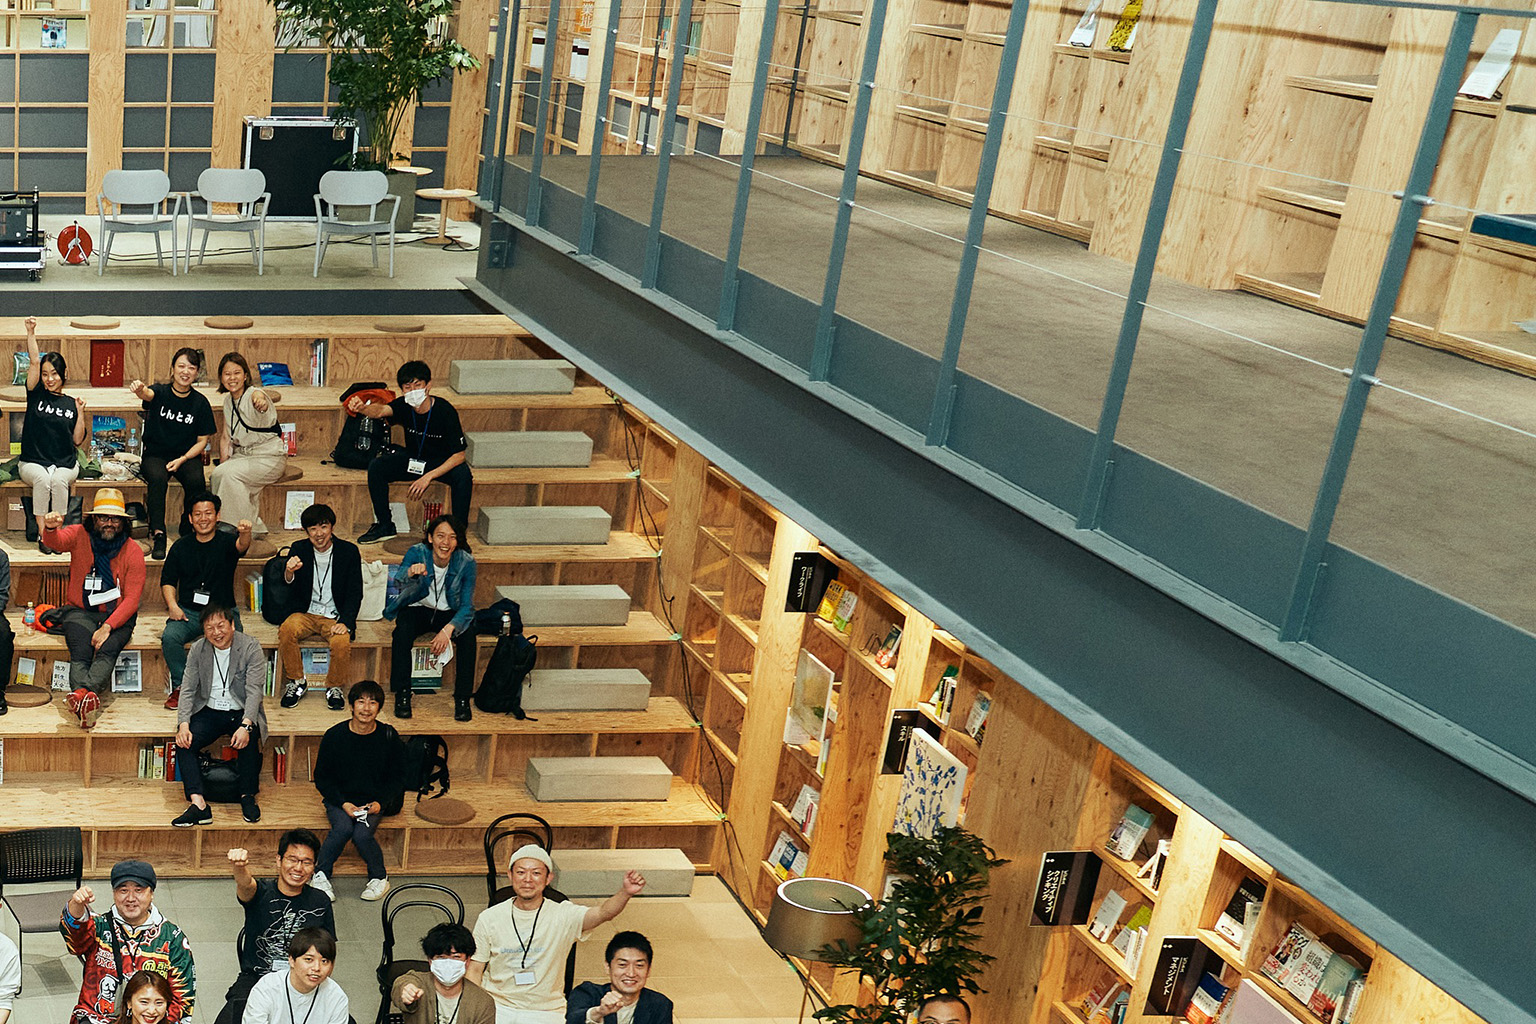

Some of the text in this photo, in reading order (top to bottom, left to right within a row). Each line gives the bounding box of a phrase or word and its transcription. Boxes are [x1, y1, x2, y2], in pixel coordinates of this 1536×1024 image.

[38, 400, 74, 419] しんとみ
[160, 406, 194, 425] しんとみ
[1041, 869, 1054, 901] シンキング
[1045, 869, 1060, 914] クリエイティブ
[1163, 956, 1180, 996] マネジメント
